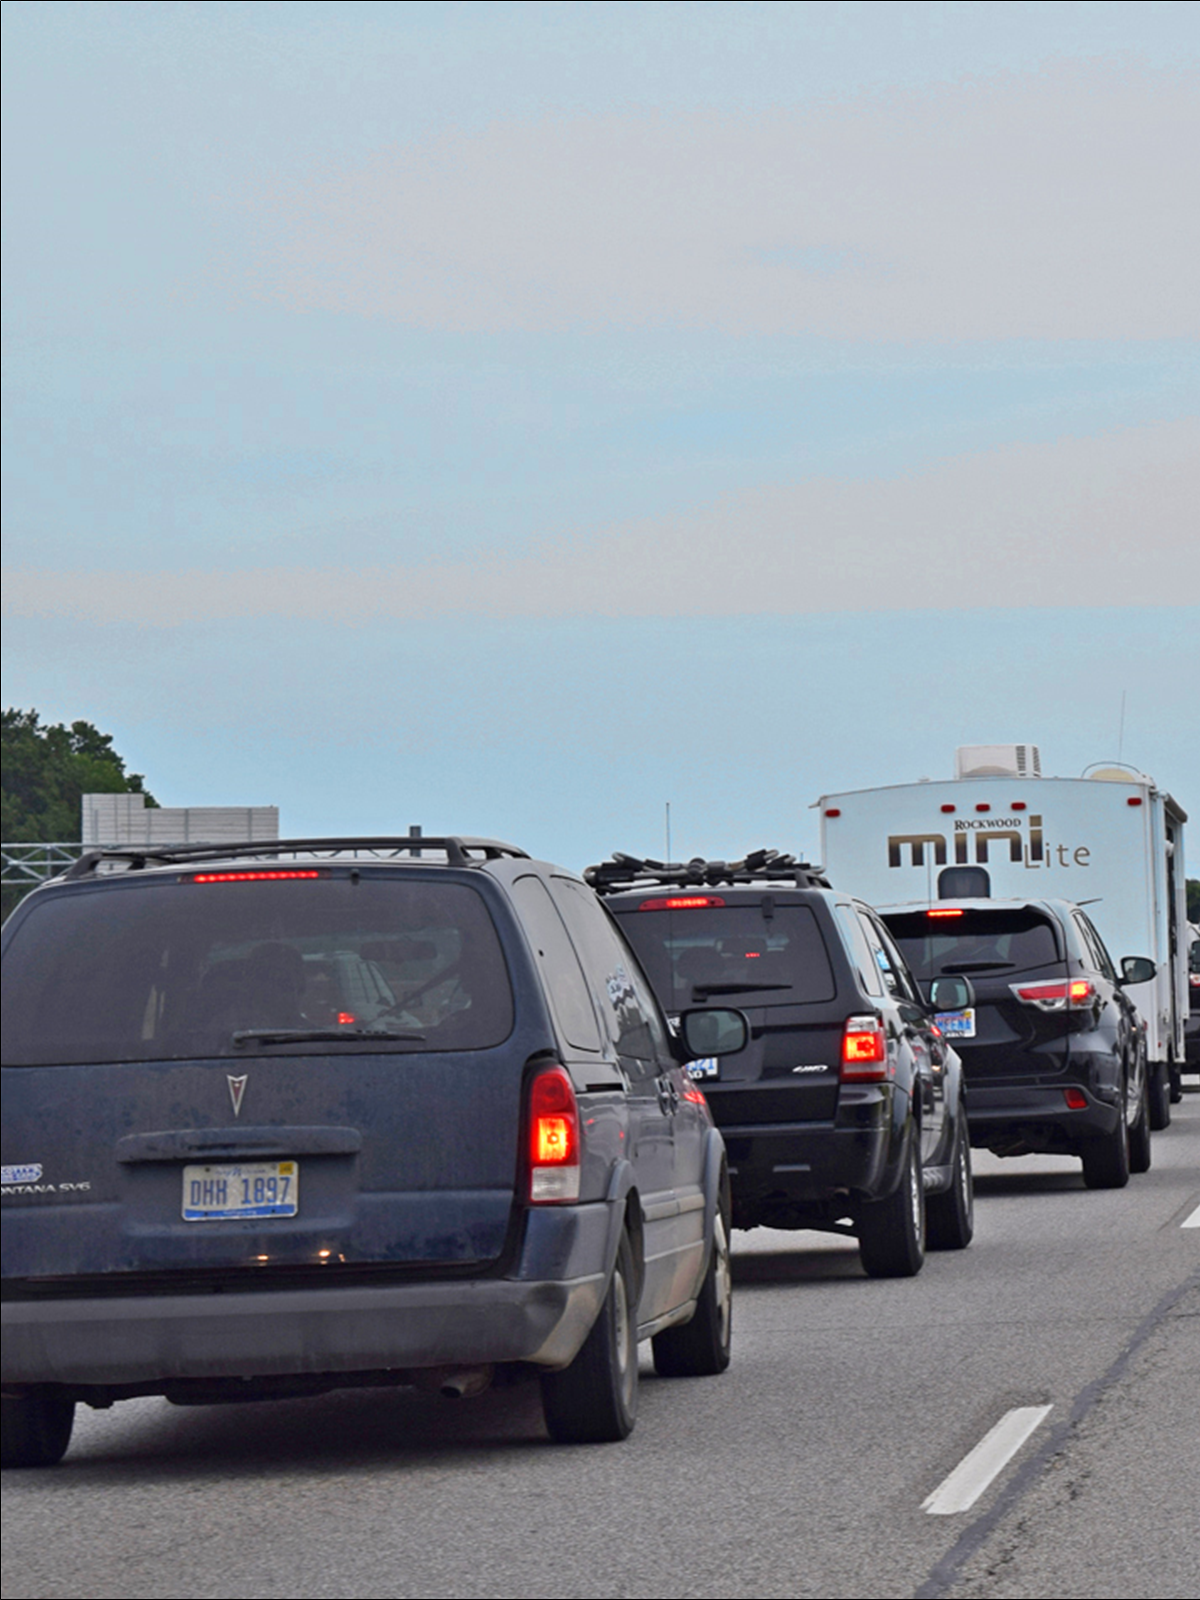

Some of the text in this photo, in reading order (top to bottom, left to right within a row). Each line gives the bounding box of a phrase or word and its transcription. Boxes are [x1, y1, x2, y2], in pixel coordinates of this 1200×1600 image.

[954, 818, 1022, 830] ROCKWOOD
[888, 815, 1091, 869] mini Lite
[59, 1181, 92, 1193] SV6
[190, 1176, 292, 1206] DHH 1897
